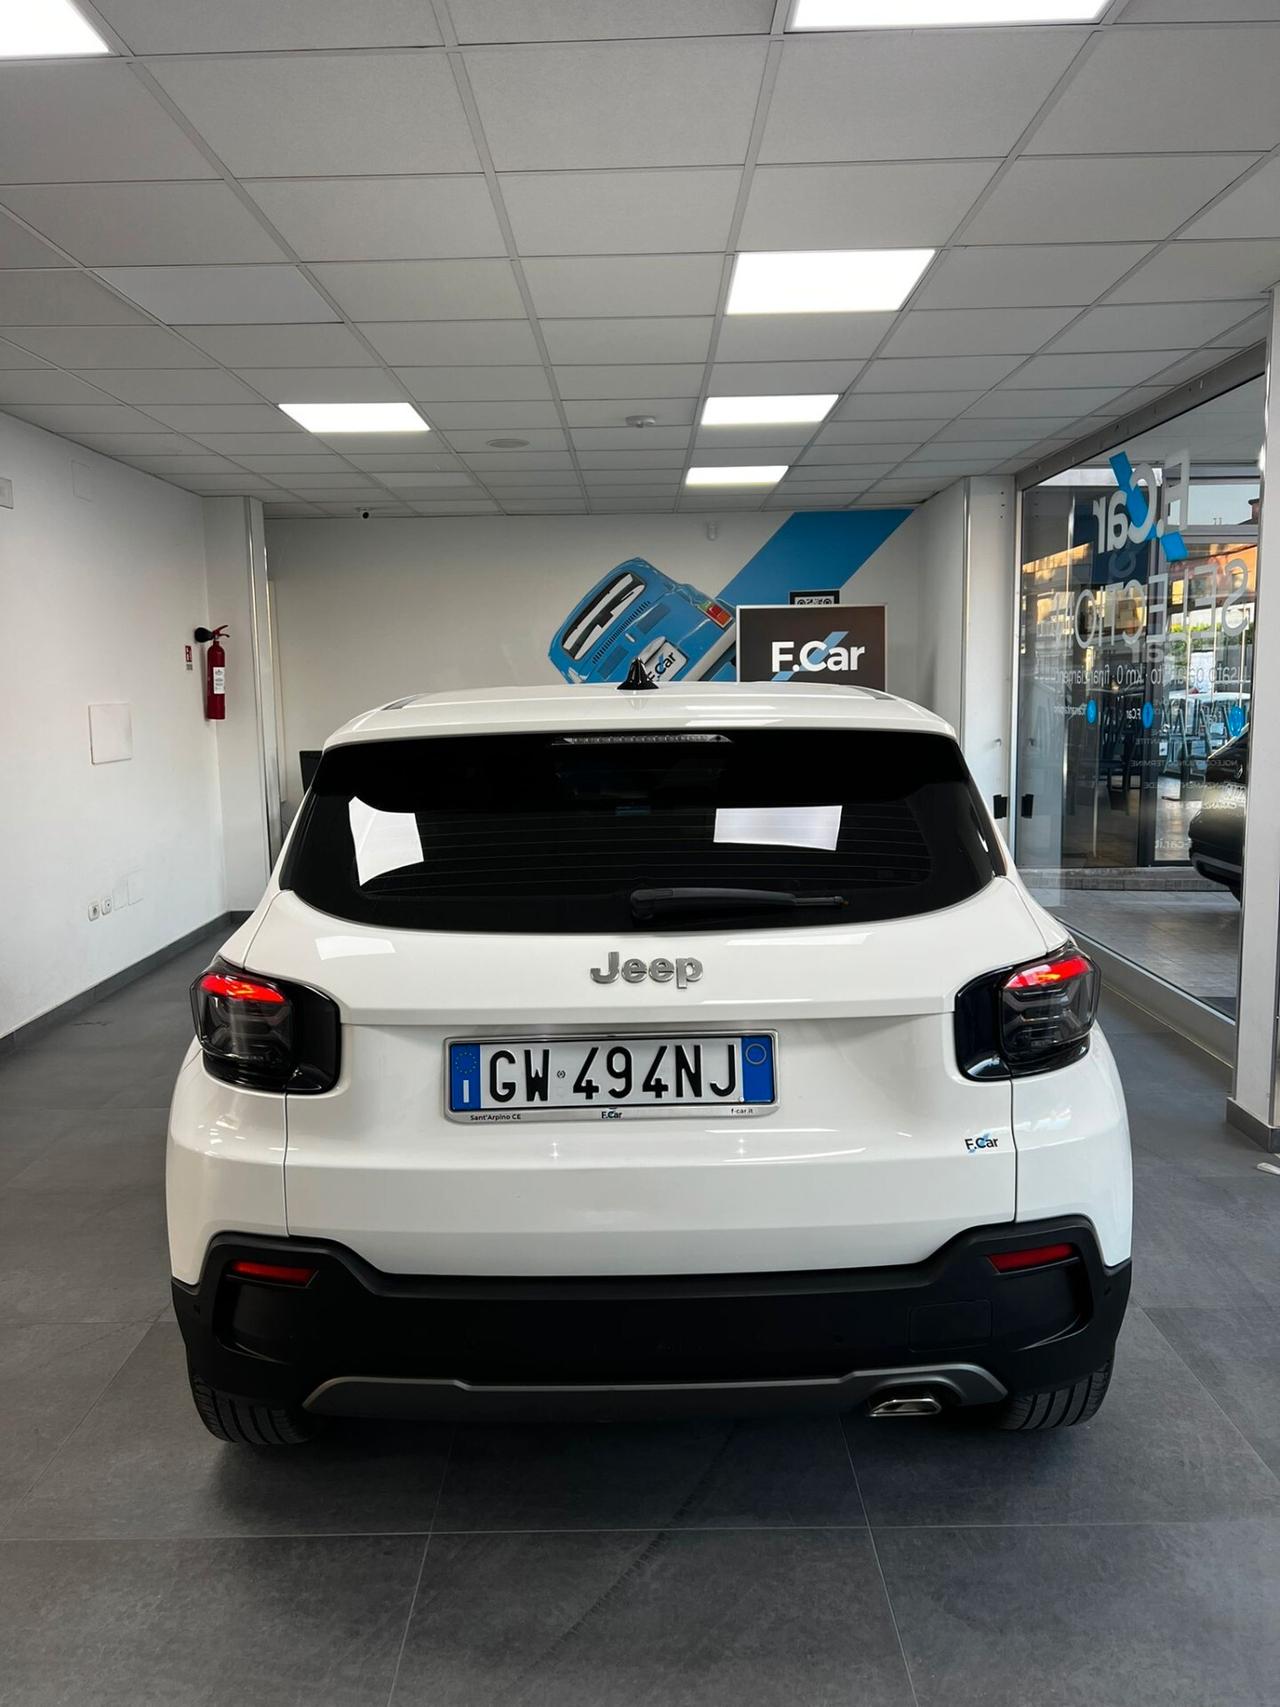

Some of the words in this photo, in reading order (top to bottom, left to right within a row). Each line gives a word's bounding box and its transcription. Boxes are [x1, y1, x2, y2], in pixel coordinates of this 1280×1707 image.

[648, 652, 676, 681] F.Car
[772, 640, 864, 673] F.Car
[590, 951, 703, 990] Jeep
[489, 1049, 550, 1103] GW
[573, 1044, 737, 1100] 494NJ
[512, 1112, 521, 1120] CE
[601, 1110, 623, 1119] F.Car
[964, 1137, 999, 1150] F.Car
